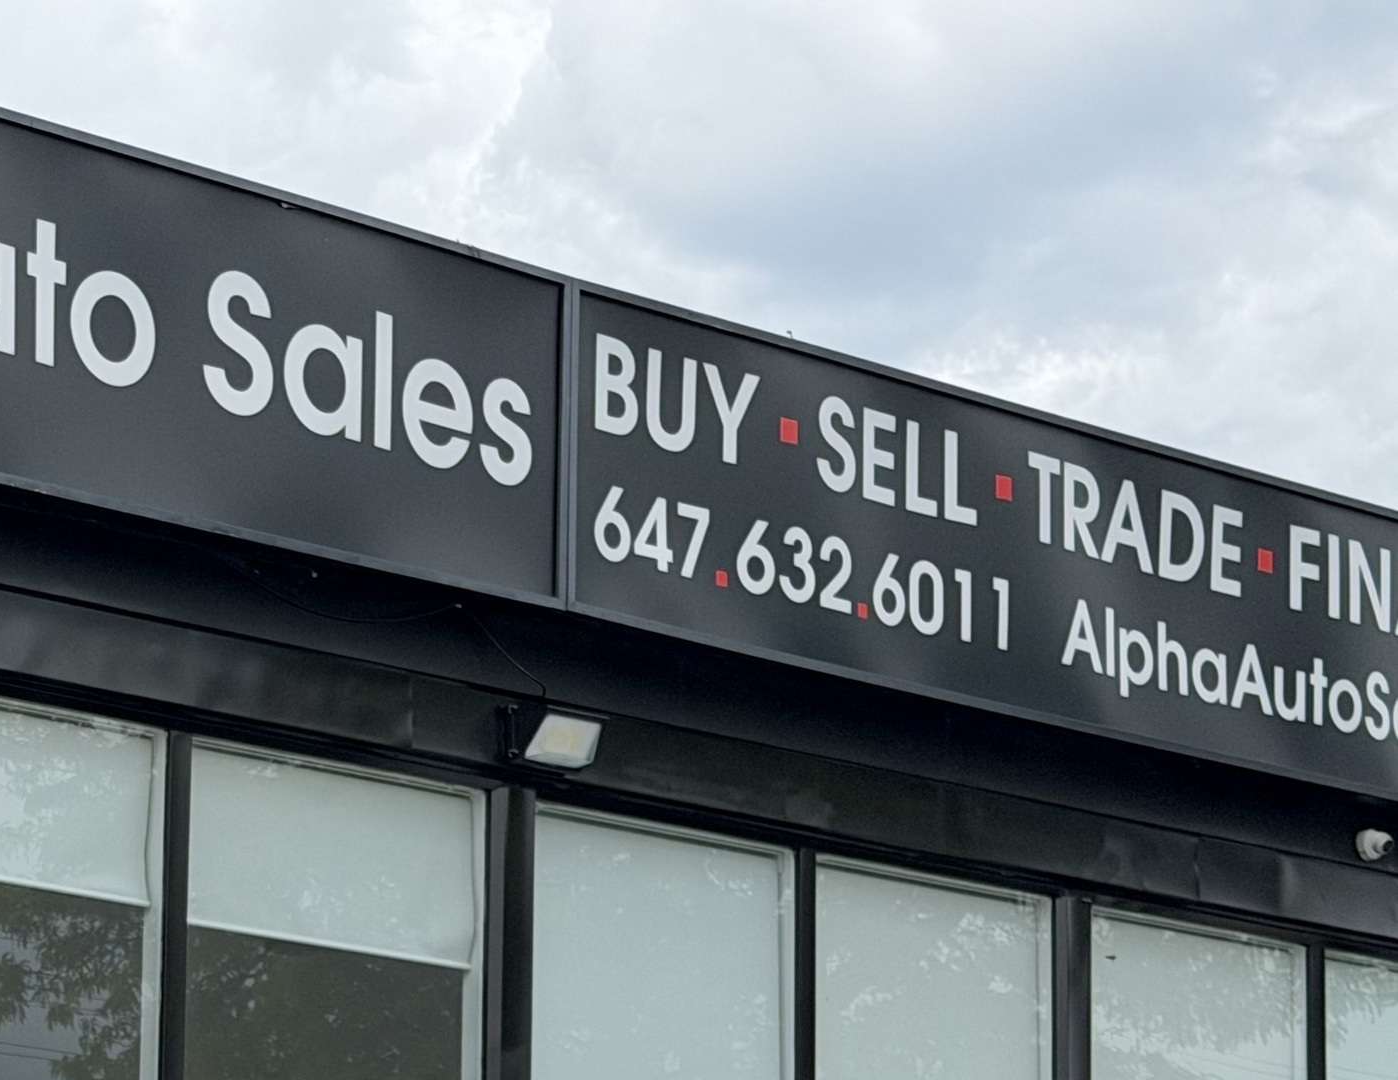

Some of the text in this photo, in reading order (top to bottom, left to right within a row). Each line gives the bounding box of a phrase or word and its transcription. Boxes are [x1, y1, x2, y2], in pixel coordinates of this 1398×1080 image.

[202, 270, 534, 486] Sales
[593, 333, 1398, 637] BUY SELL TRADE FIN
[593, 485, 1010, 651] 647.632.6011
[1061, 598, 1398, 741] AlphaAutoS
